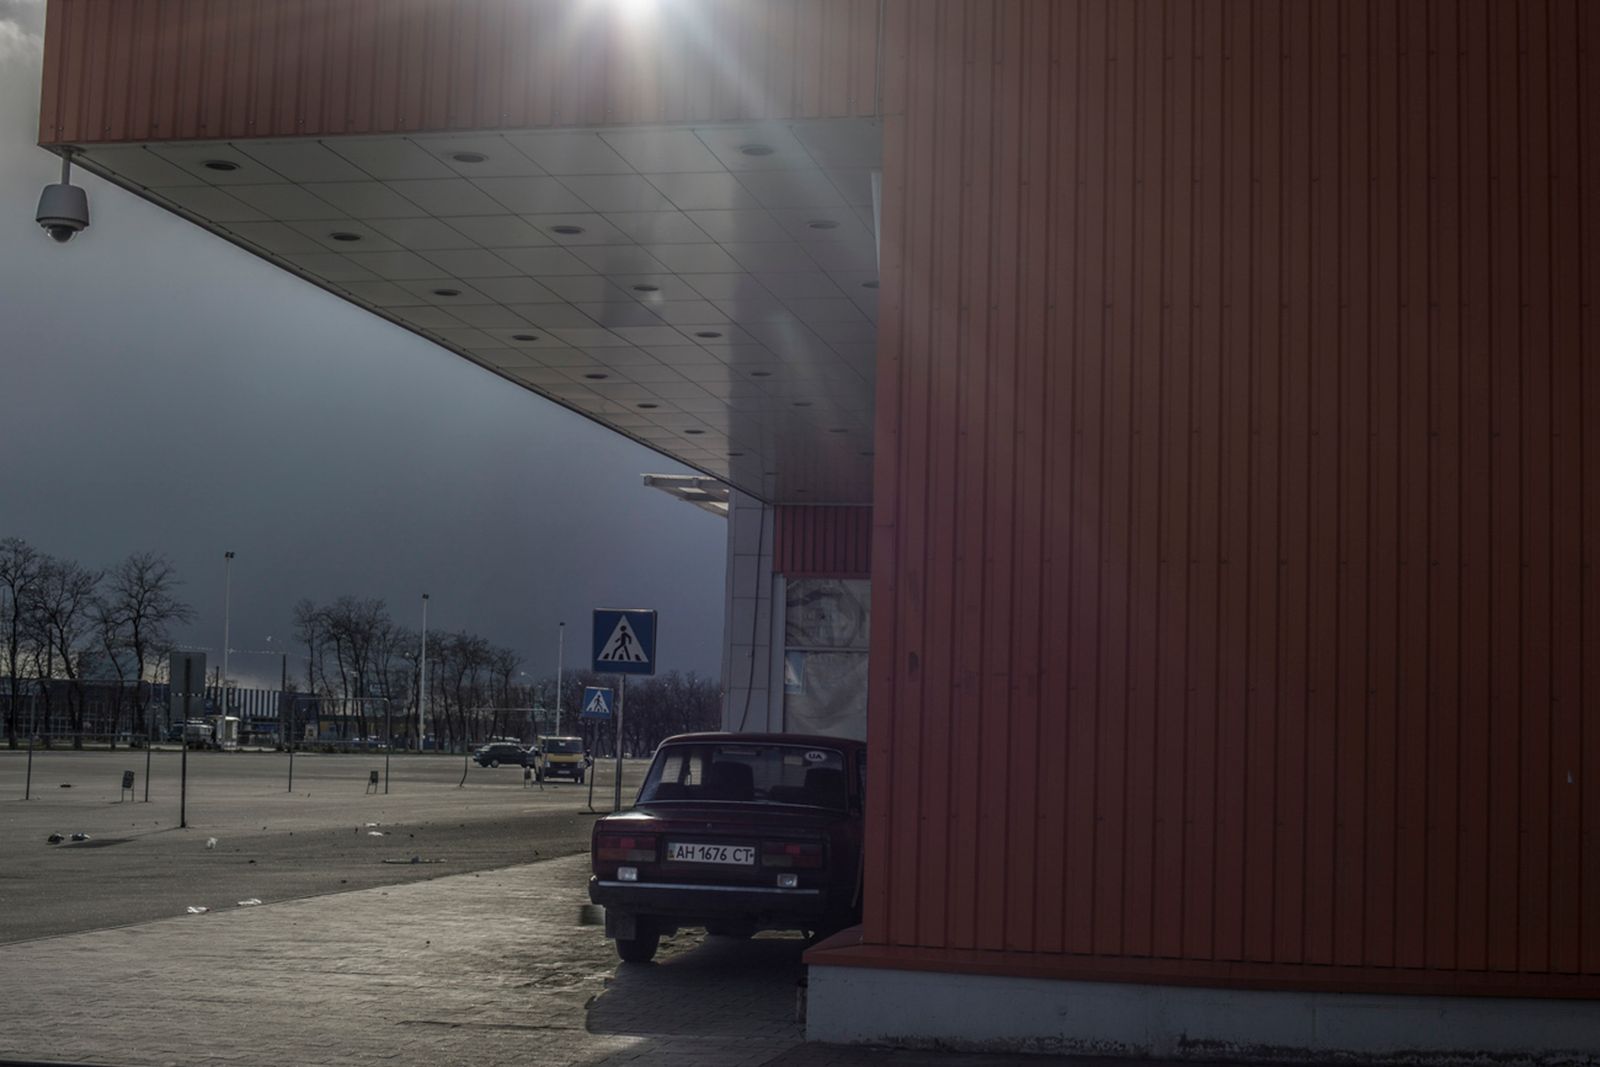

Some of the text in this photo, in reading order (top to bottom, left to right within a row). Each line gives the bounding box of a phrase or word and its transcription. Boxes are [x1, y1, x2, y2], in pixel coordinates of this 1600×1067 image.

[676, 845, 752, 862] AH 1676 CT
